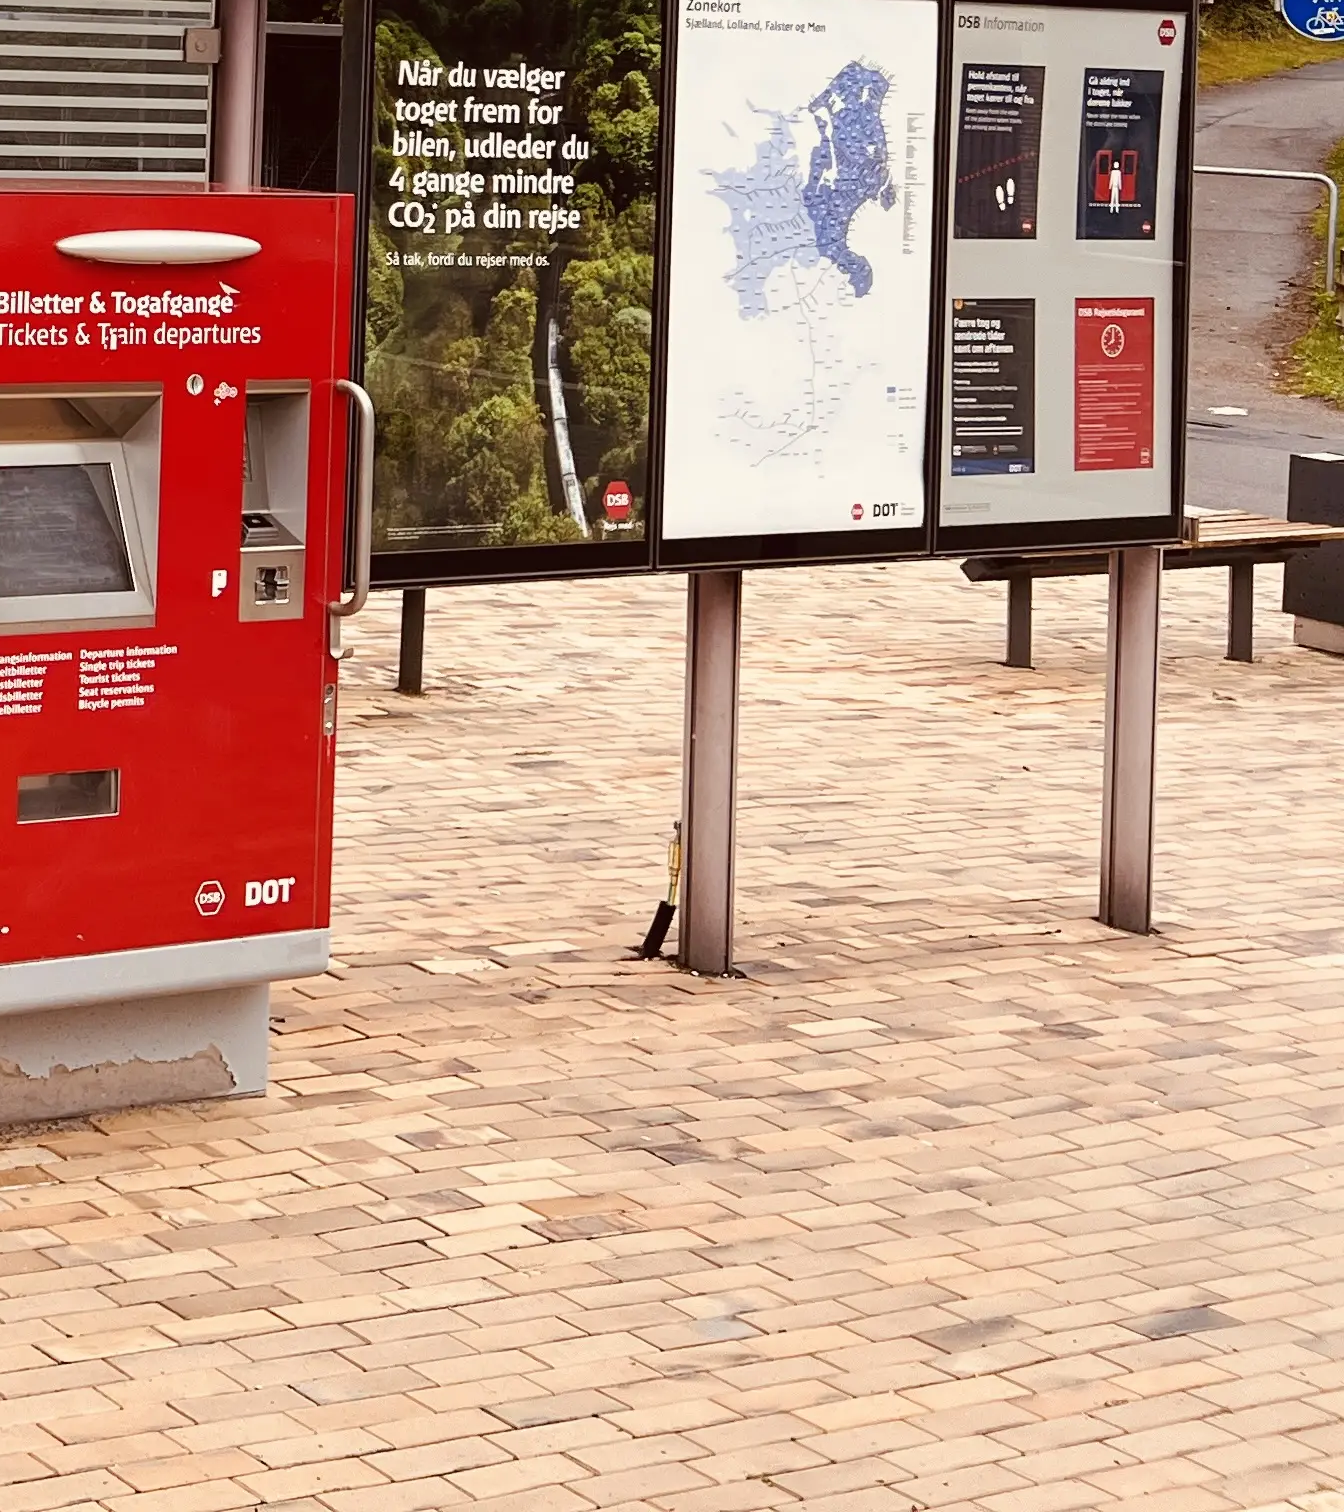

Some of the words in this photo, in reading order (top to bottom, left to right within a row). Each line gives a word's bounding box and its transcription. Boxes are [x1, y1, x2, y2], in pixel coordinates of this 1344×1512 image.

[727, 19, 762, 33] Lolland,
[765, 21, 794, 32] Falster
[795, 24, 806, 34] og
[958, 15, 981, 29] DSB
[983, 17, 1045, 33] Information
[398, 59, 444, 87] Når
[448, 61, 476, 88] du
[483, 63, 565, 94] vælger
[395, 98, 458, 127] toget
[463, 96, 520, 124] frem
[528, 98, 563, 125] for
[392, 129, 456, 162] bilen,
[464, 132, 556, 160] udleder
[561, 134, 589, 160] du
[388, 166, 405, 192] 4
[413, 170, 485, 198] gange
[492, 168, 574, 194] mindre
[445, 201, 476, 234] på
[483, 202, 521, 229] din
[528, 204, 581, 235] rejse
[386, 251, 400, 266] Så
[403, 251, 424, 268] tak,
[428, 252, 455, 267] fordi
[457, 252, 472, 266] du
[476, 253, 507, 269] rejser
[510, 252, 533, 267] med
[535, 254, 550, 267] os.
[89, 291, 106, 315] &
[111, 290, 234, 318] Togafgange
[75, 322, 91, 345] &
[97, 322, 147, 347] Train
[154, 321, 261, 349] departures
[606, 493, 629, 507] DSB
[873, 502, 899, 518] DOT
[80, 647, 124, 661] Departure
[126, 644, 178, 657] information
[79, 660, 107, 673] Single
[109, 659, 125, 672] trip
[126, 658, 155, 669] tickets
[79, 673, 110, 685] Tourist
[111, 672, 141, 683] tickets
[78, 686, 99, 698] Seat
[100, 684, 155, 696] reservations
[78, 698, 110, 711] Bicycle
[111, 696, 145, 709] permits
[198, 891, 221, 905] DSB
[245, 877, 296, 906] DOT
